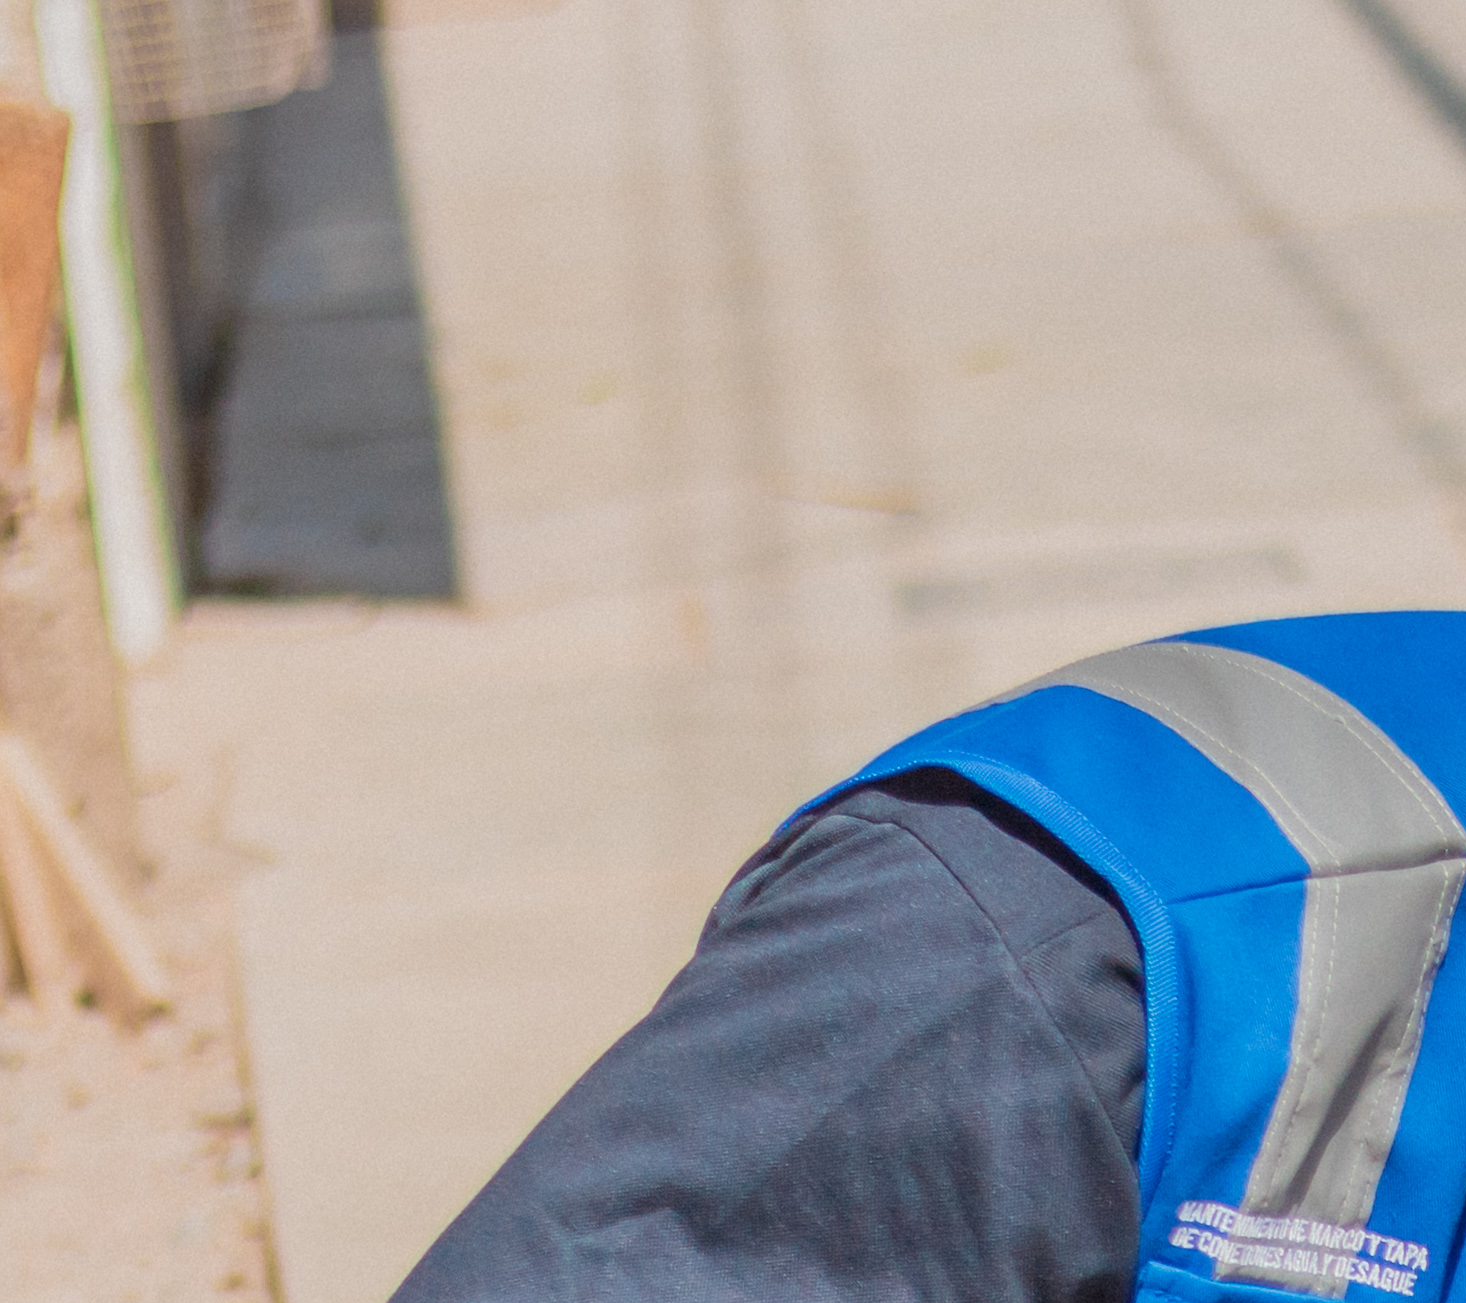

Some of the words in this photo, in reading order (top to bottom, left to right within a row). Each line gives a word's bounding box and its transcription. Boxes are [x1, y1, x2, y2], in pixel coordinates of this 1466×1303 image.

[1171, 1226, 1200, 1249] DE
[1334, 1256, 1418, 1297] DESAGUE
[1309, 1221, 1366, 1252] MARCO
[1364, 1233, 1383, 1257] Y
[1381, 1238, 1428, 1272] TAPA
